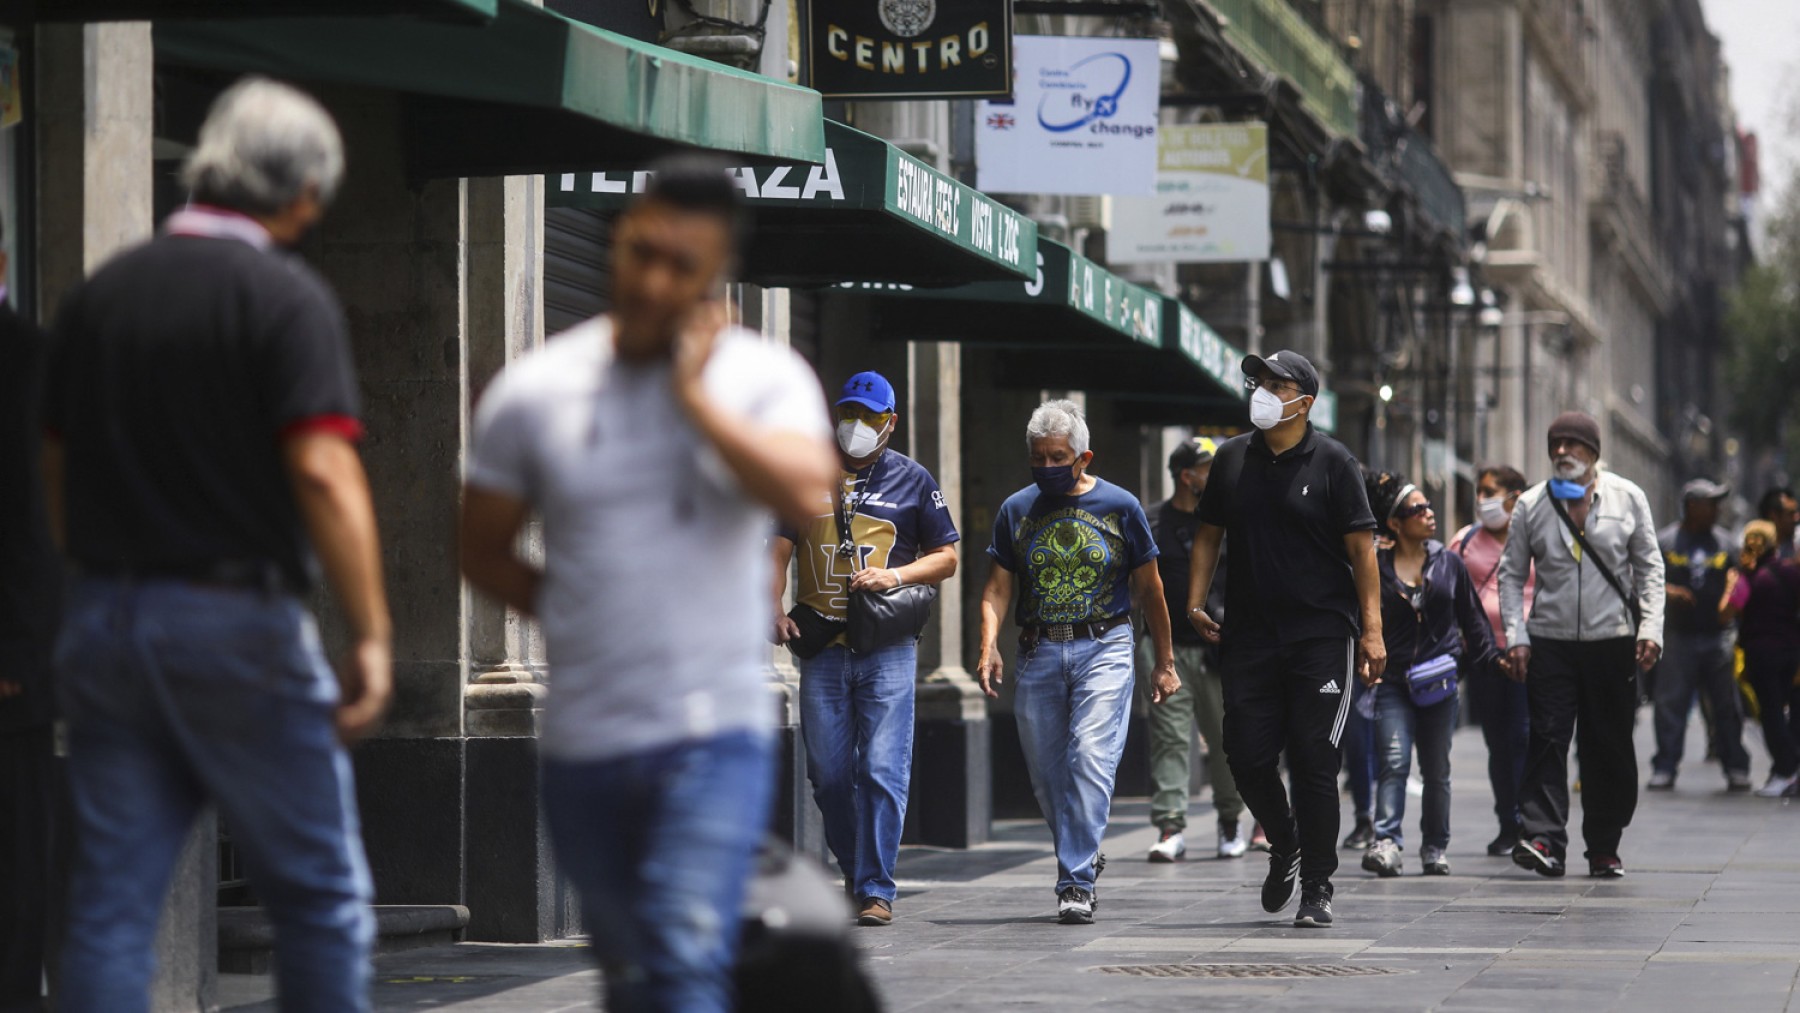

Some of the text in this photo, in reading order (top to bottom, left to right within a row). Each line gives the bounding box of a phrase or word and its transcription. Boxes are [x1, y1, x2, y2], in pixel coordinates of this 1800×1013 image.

[828, 21, 988, 74] CENTRO
[1071, 93, 1094, 112] fly
[1090, 120, 1154, 138] change
[971, 196, 992, 254] VISTA
